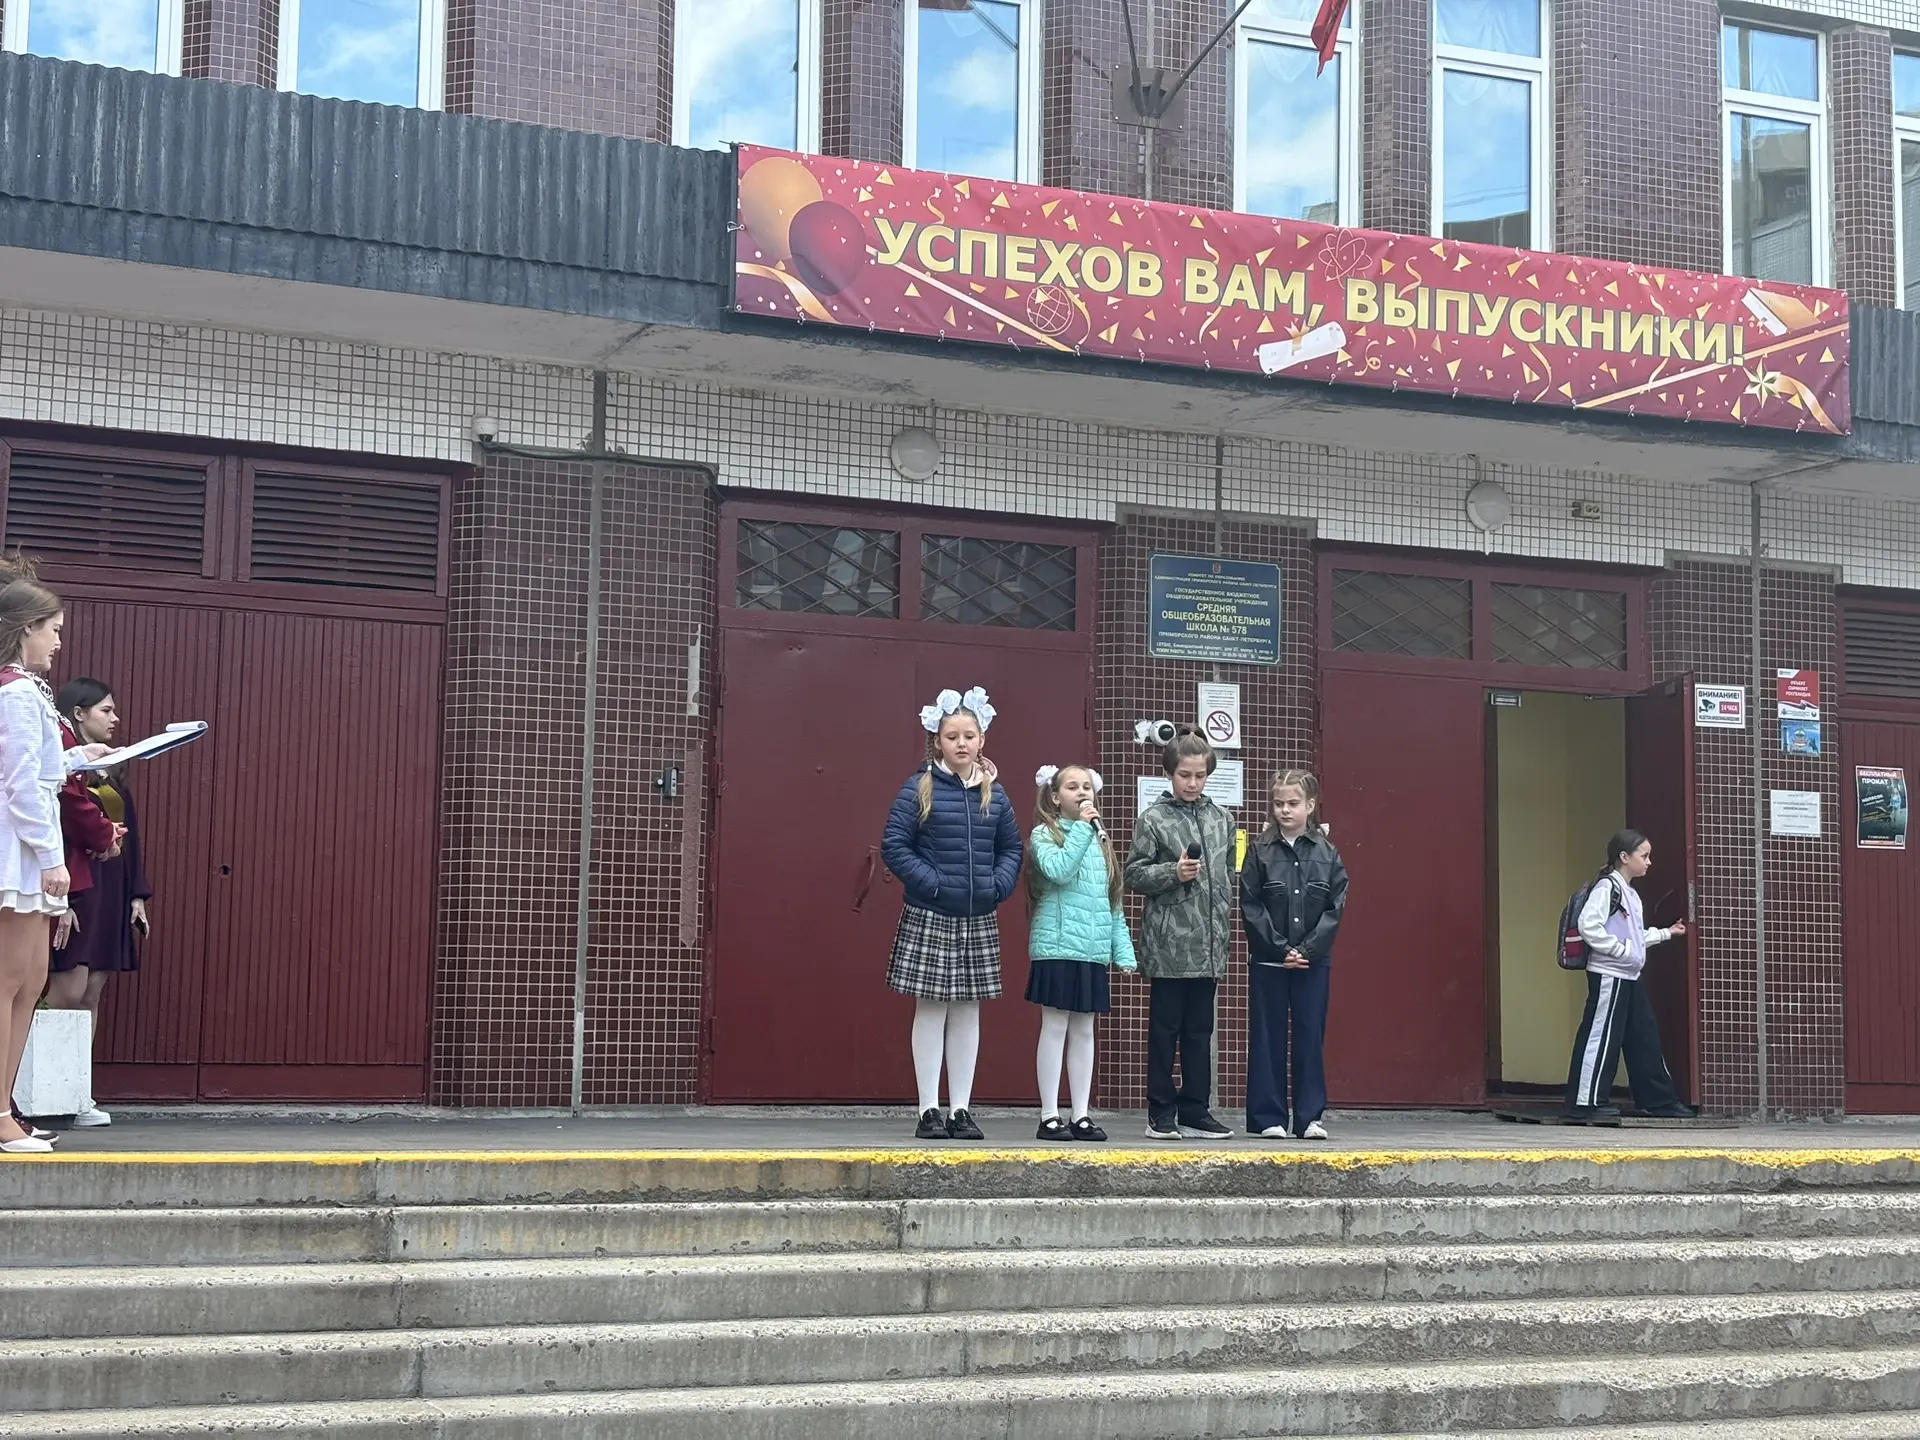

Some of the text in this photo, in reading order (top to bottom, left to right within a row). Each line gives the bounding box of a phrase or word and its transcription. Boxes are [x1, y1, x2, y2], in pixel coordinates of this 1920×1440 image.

[873, 216, 1746, 367] УСПЕХОВ ВАМ, ВЫПУСКНИКИ!
[1196, 602, 1237, 614] СРЕДНЯЯ
[1161, 610, 1271, 627] ОБЩЕОБРАЗОВАТЕЛЬНАЯ
[1186, 622, 1218, 633] ШКОЛА
[1231, 625, 1247, 635] 578
[1698, 690, 1740, 700] ВНИМАНИЕ!
[1859, 770, 1897, 778] БЕСПЛАТНЫЙ
[1861, 777, 1889, 786] ПРОКАТ
